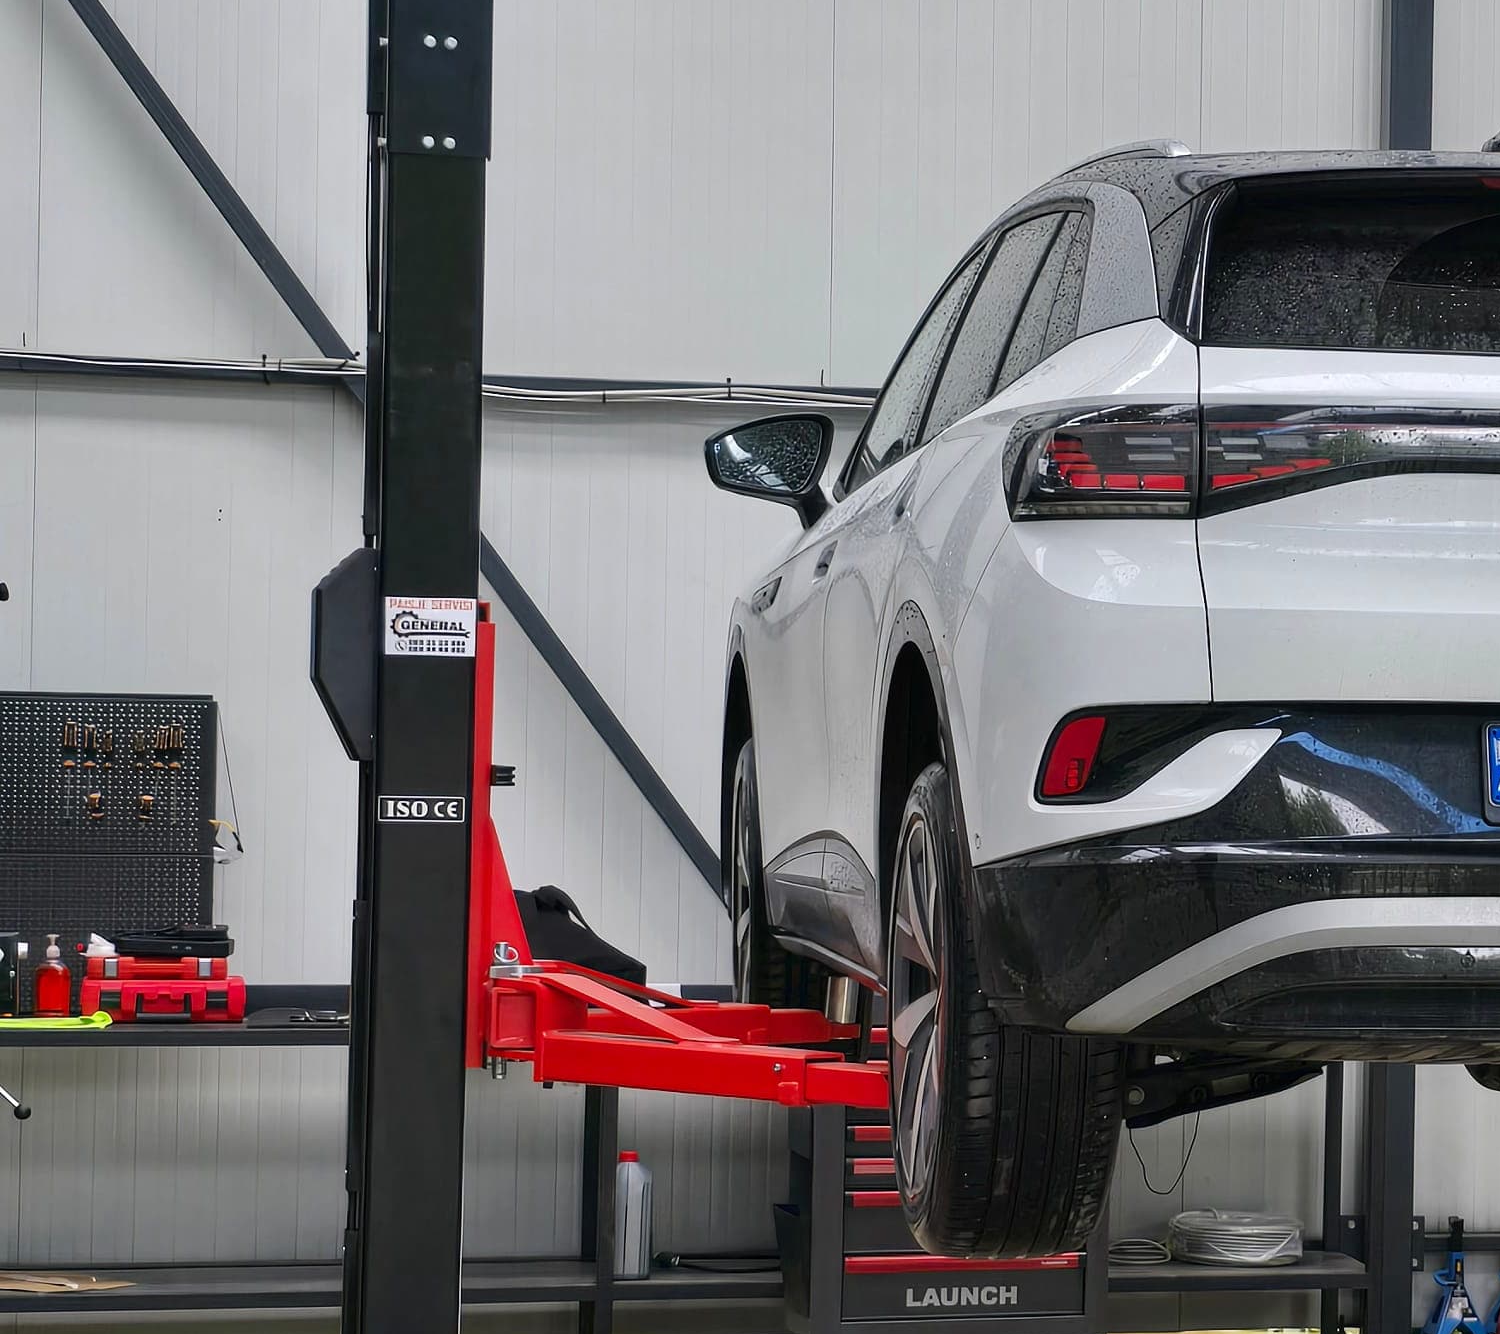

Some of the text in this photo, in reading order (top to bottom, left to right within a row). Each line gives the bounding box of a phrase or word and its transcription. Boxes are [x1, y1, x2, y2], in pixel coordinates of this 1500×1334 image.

[401, 620, 466, 631] GENERAL
[387, 800, 428, 817] ISO
[906, 1285, 1018, 1307] LAUNCH
